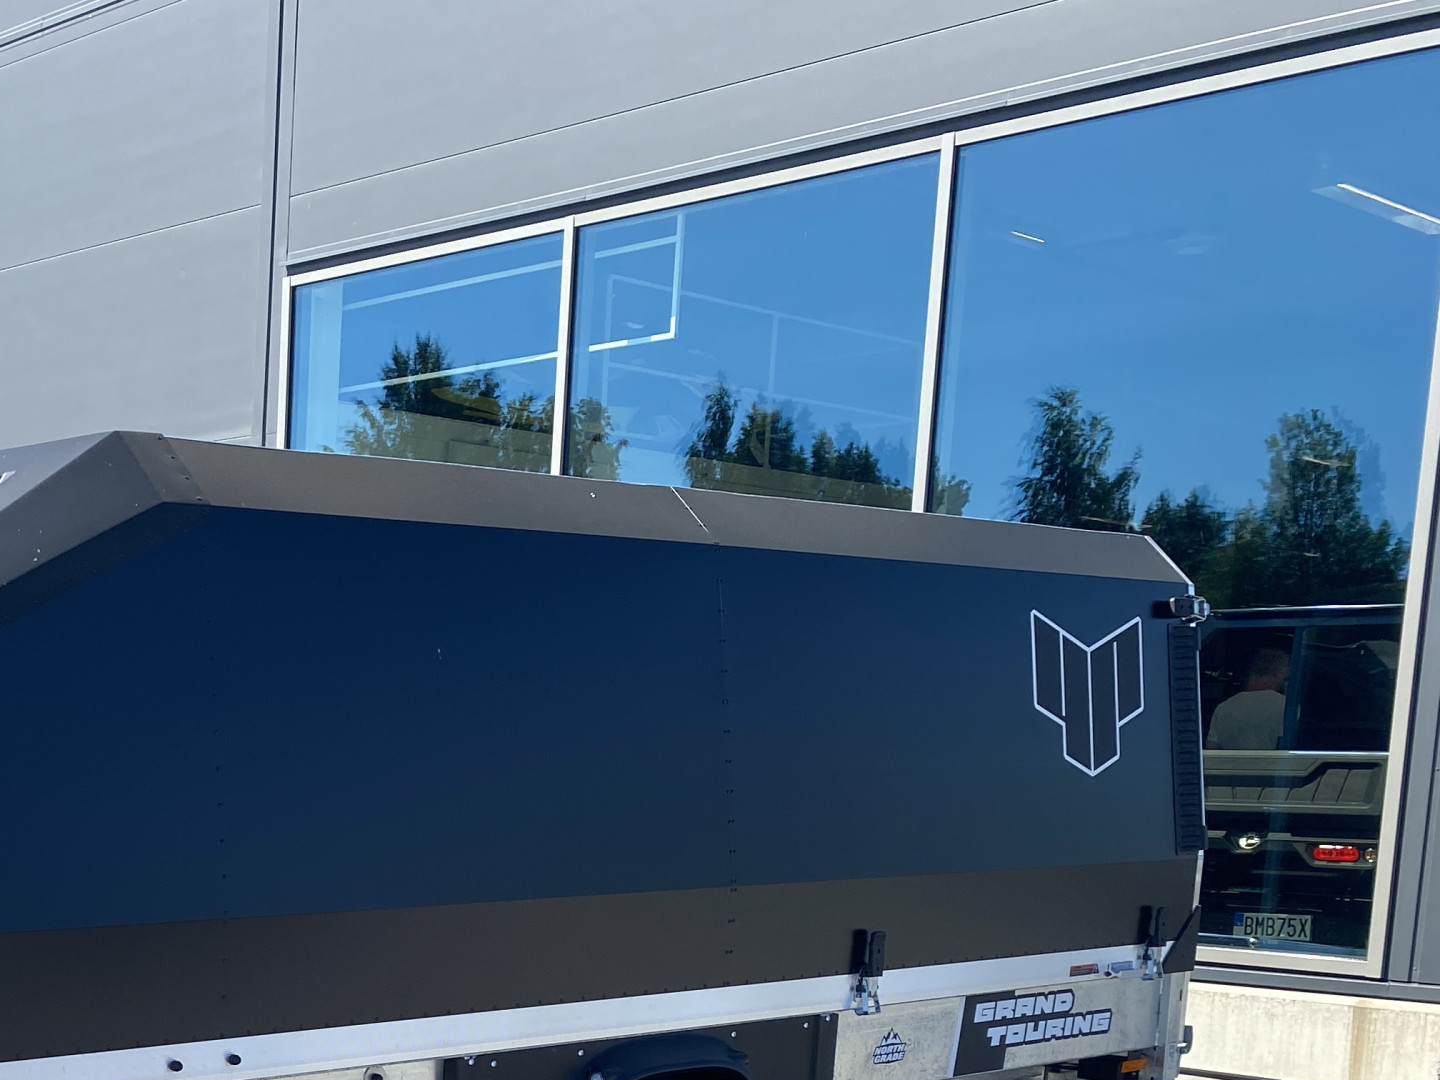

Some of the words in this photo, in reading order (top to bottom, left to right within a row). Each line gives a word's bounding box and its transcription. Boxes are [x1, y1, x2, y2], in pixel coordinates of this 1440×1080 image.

[1244, 916, 1308, 938] BMB75X
[973, 991, 1074, 1024] GRAND
[986, 1011, 1112, 1047] TOURING
[874, 1043, 906, 1056] NORTH
[874, 1051, 905, 1064] GRADE
